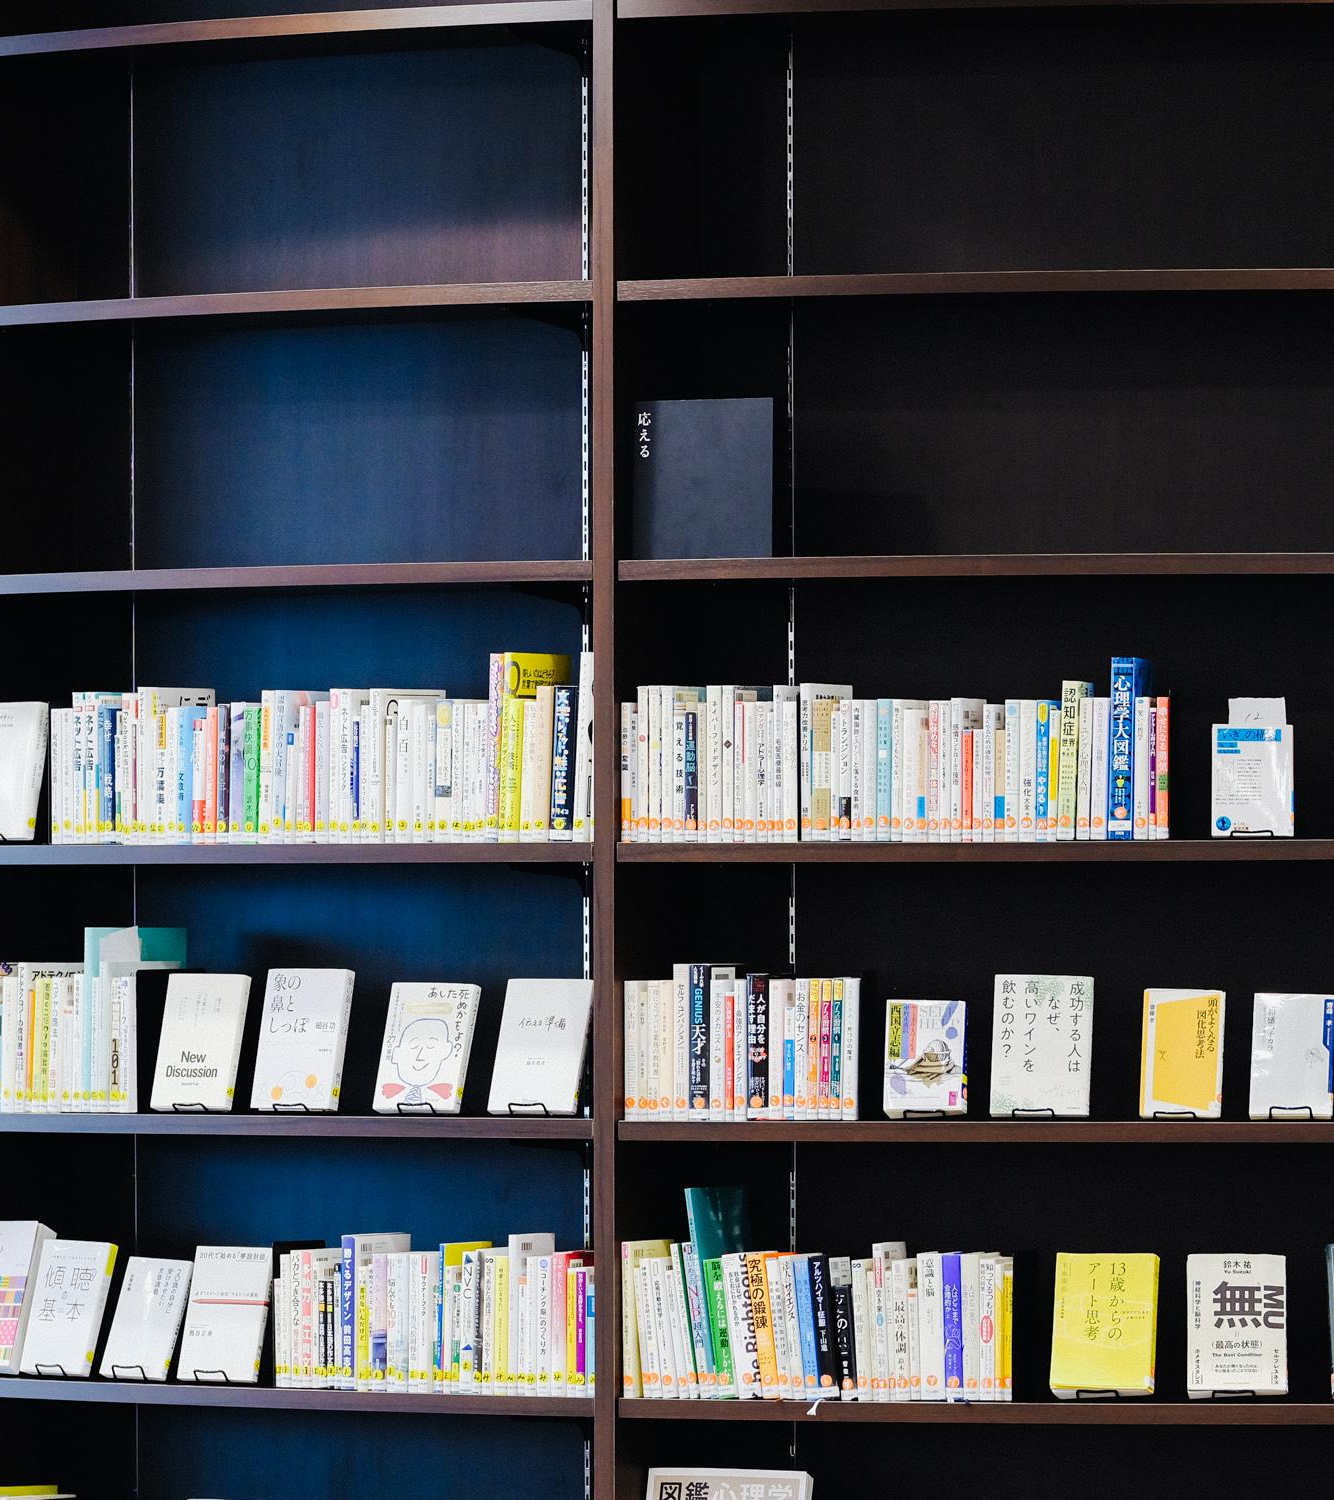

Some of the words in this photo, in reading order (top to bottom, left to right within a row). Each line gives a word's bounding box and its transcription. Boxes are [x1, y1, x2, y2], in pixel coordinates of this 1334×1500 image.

[638, 412, 651, 458] 応える
[181, 1051, 206, 1063] New
[1023, 981, 1040, 1072] 高いワインを
[1067, 982, 1085, 1072] 成功する人は
[165, 1065, 218, 1079] Discussion
[1084, 1262, 1101, 1340] アート思考
[1108, 1262, 1126, 1340] 13歳からの
[1212, 1281, 1263, 1329] 無
